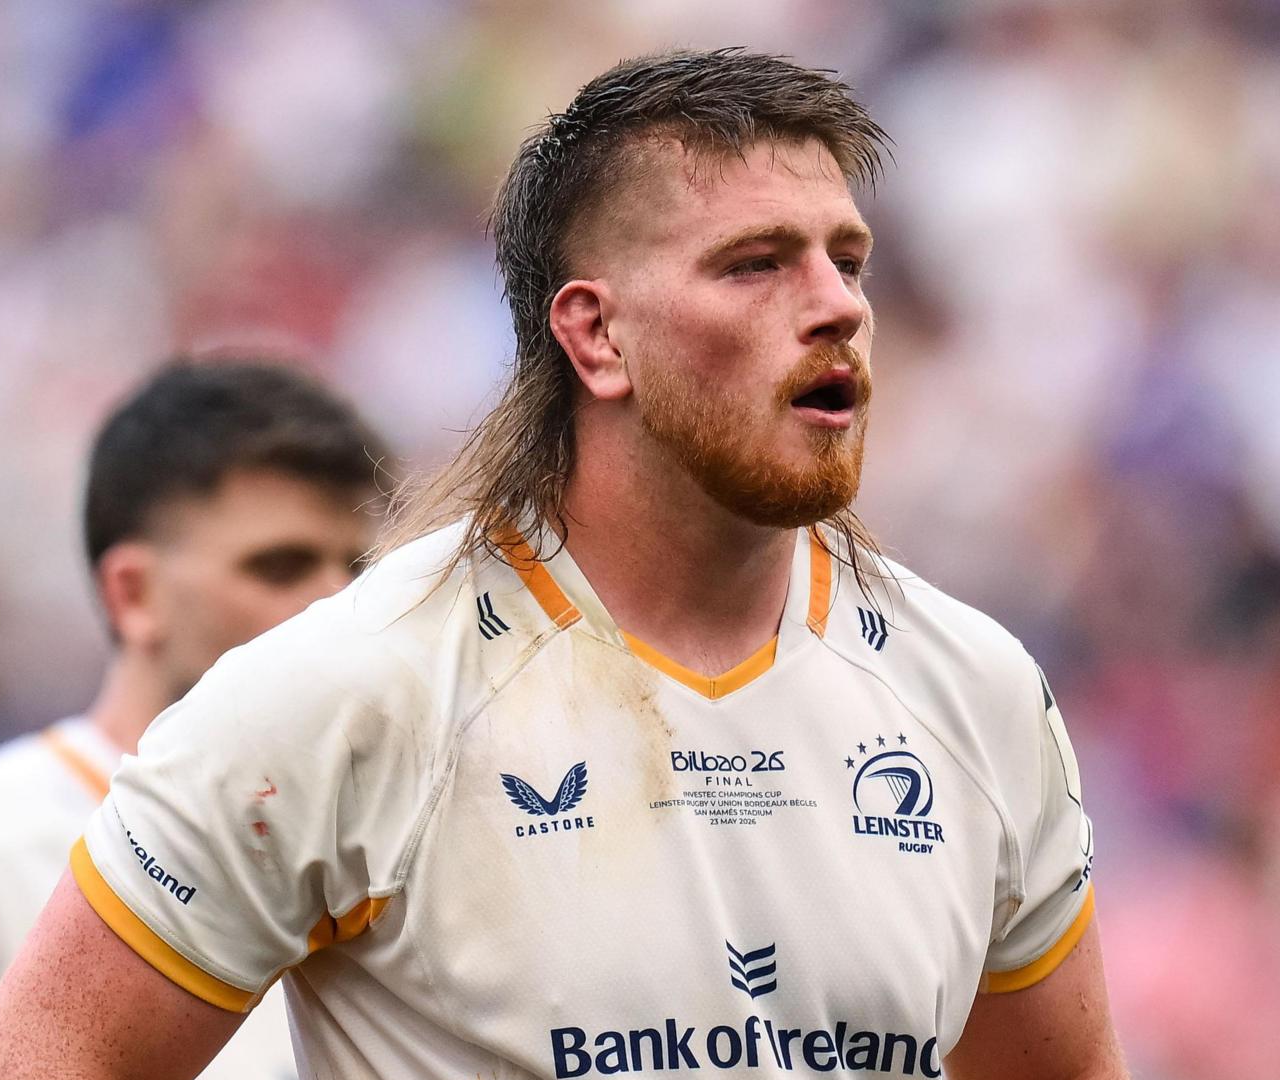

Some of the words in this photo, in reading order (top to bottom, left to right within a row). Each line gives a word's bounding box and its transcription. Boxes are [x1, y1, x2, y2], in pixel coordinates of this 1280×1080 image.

[671, 750, 747, 773] Bilbao
[750, 750, 786, 773] 26
[705, 776, 753, 787] FINAL
[682, 791, 717, 799] INVESTEC
[718, 791, 764, 799] CHAMPIONS
[649, 800, 686, 809] LEINSTER
[686, 800, 709, 808] RUGBY
[717, 800, 743, 808] UNION
[744, 800, 788, 808] BORDEAUX
[739, 809, 773, 817] STADIUM
[515, 816, 595, 838] CASTORE
[710, 818, 719, 826] 23
[739, 818, 757, 826] 2026
[852, 815, 945, 844] LEINSTER
[898, 841, 934, 855] RUGBY
[126, 830, 197, 906] reland
[549, 1017, 701, 1080] Bank
[706, 1014, 761, 1070] of
